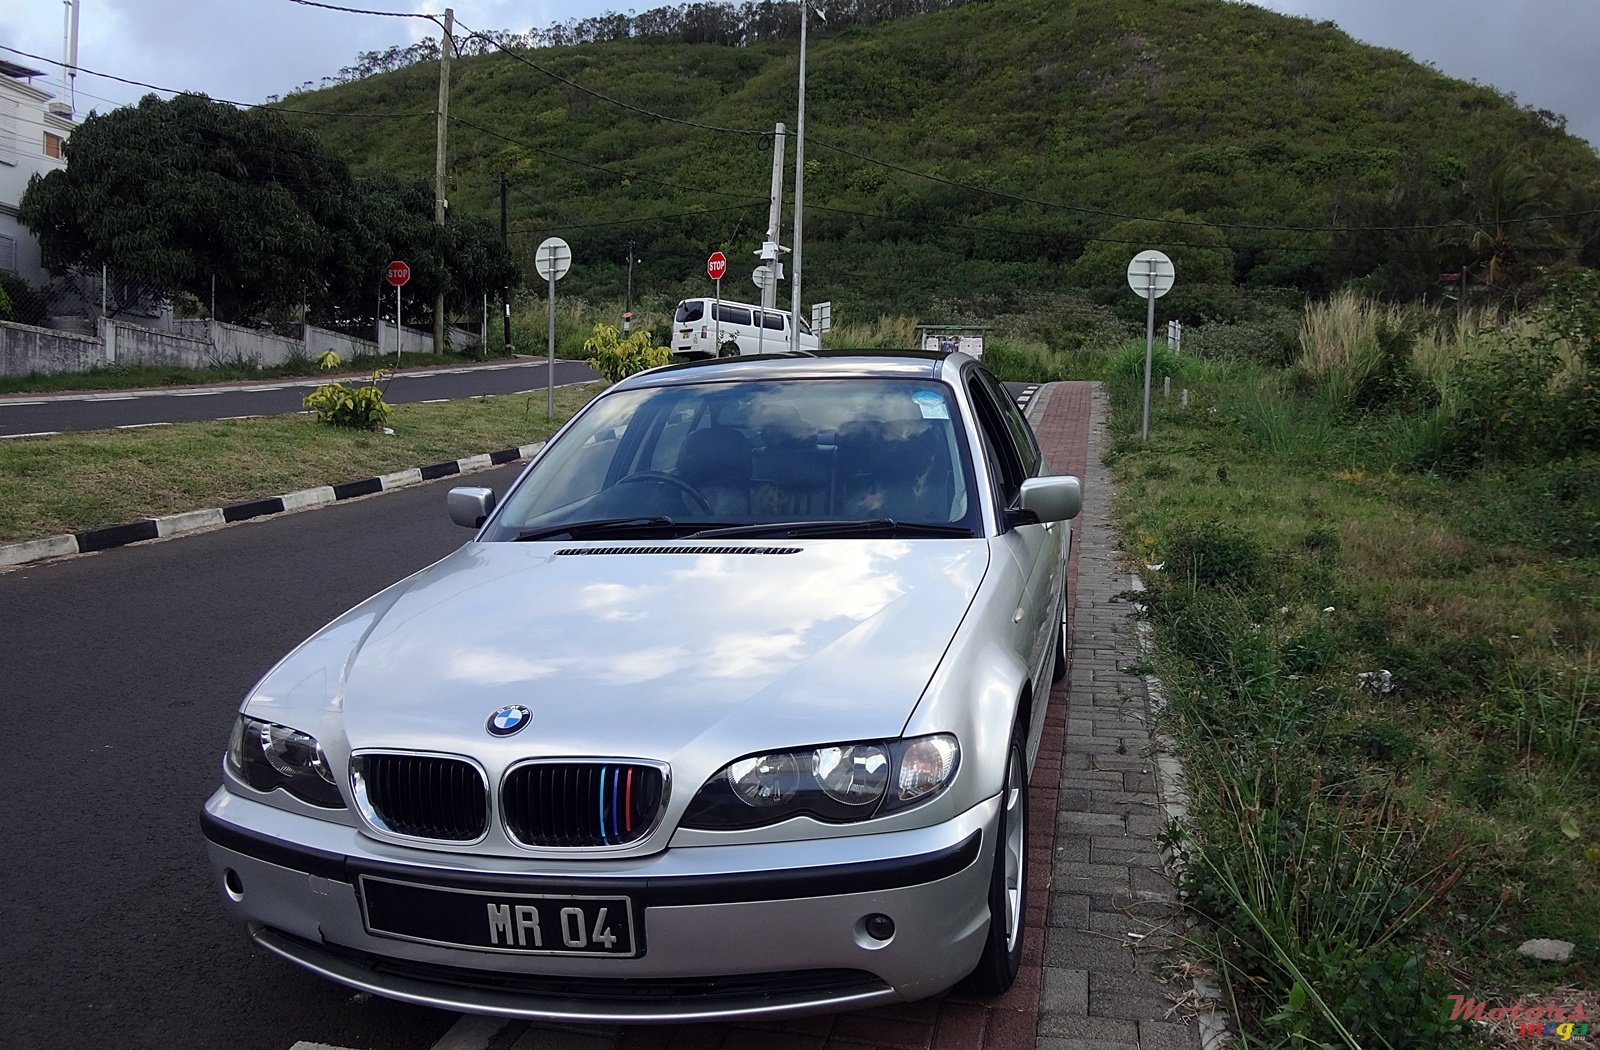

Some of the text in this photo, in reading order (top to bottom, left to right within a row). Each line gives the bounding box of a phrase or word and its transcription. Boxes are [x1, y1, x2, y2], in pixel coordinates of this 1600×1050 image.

[709, 260, 725, 271] STOP
[388, 268, 408, 278] STOP
[487, 903, 617, 949] MR 04
